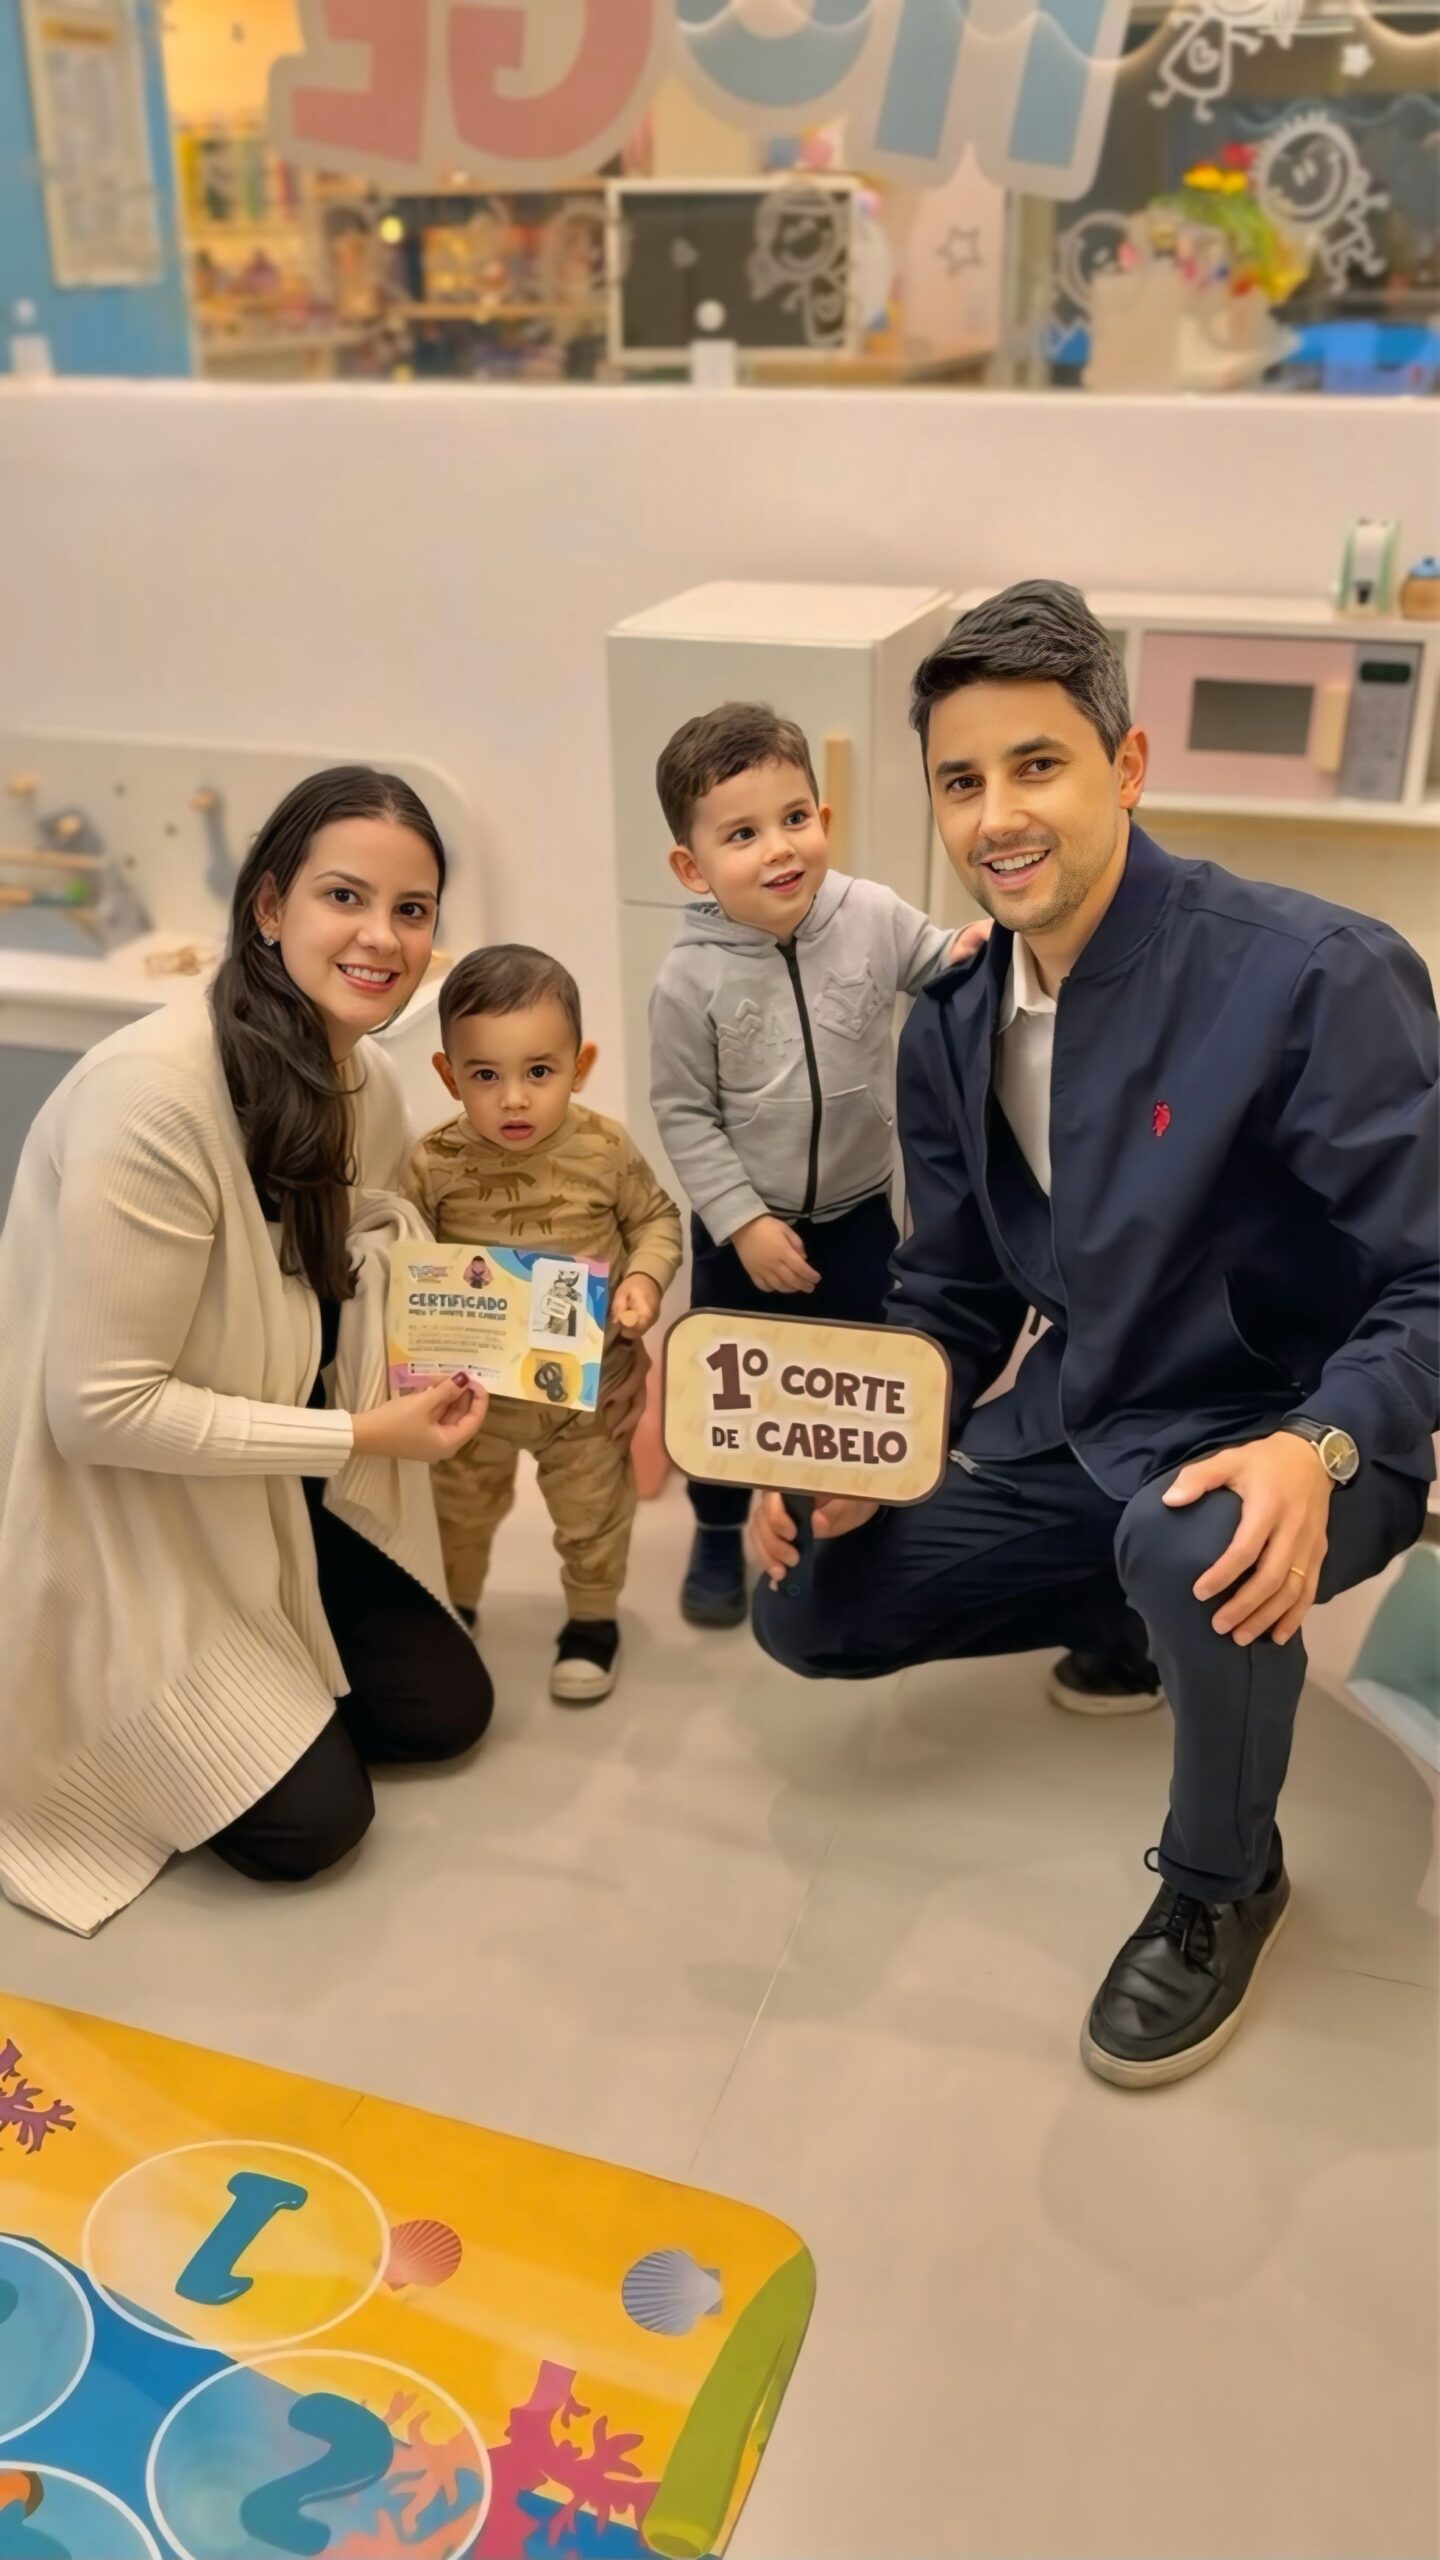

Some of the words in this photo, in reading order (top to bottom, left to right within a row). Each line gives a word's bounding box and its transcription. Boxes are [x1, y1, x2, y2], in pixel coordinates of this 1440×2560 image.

[408, 1293, 508, 1311] CERTIFICADO
[781, 1365, 905, 1414] CORTE
[711, 1426, 740, 1449] DE
[756, 1421, 907, 1464] CABELO
[175, 2171, 309, 2305] 1
[239, 2392, 394, 2556] 2
